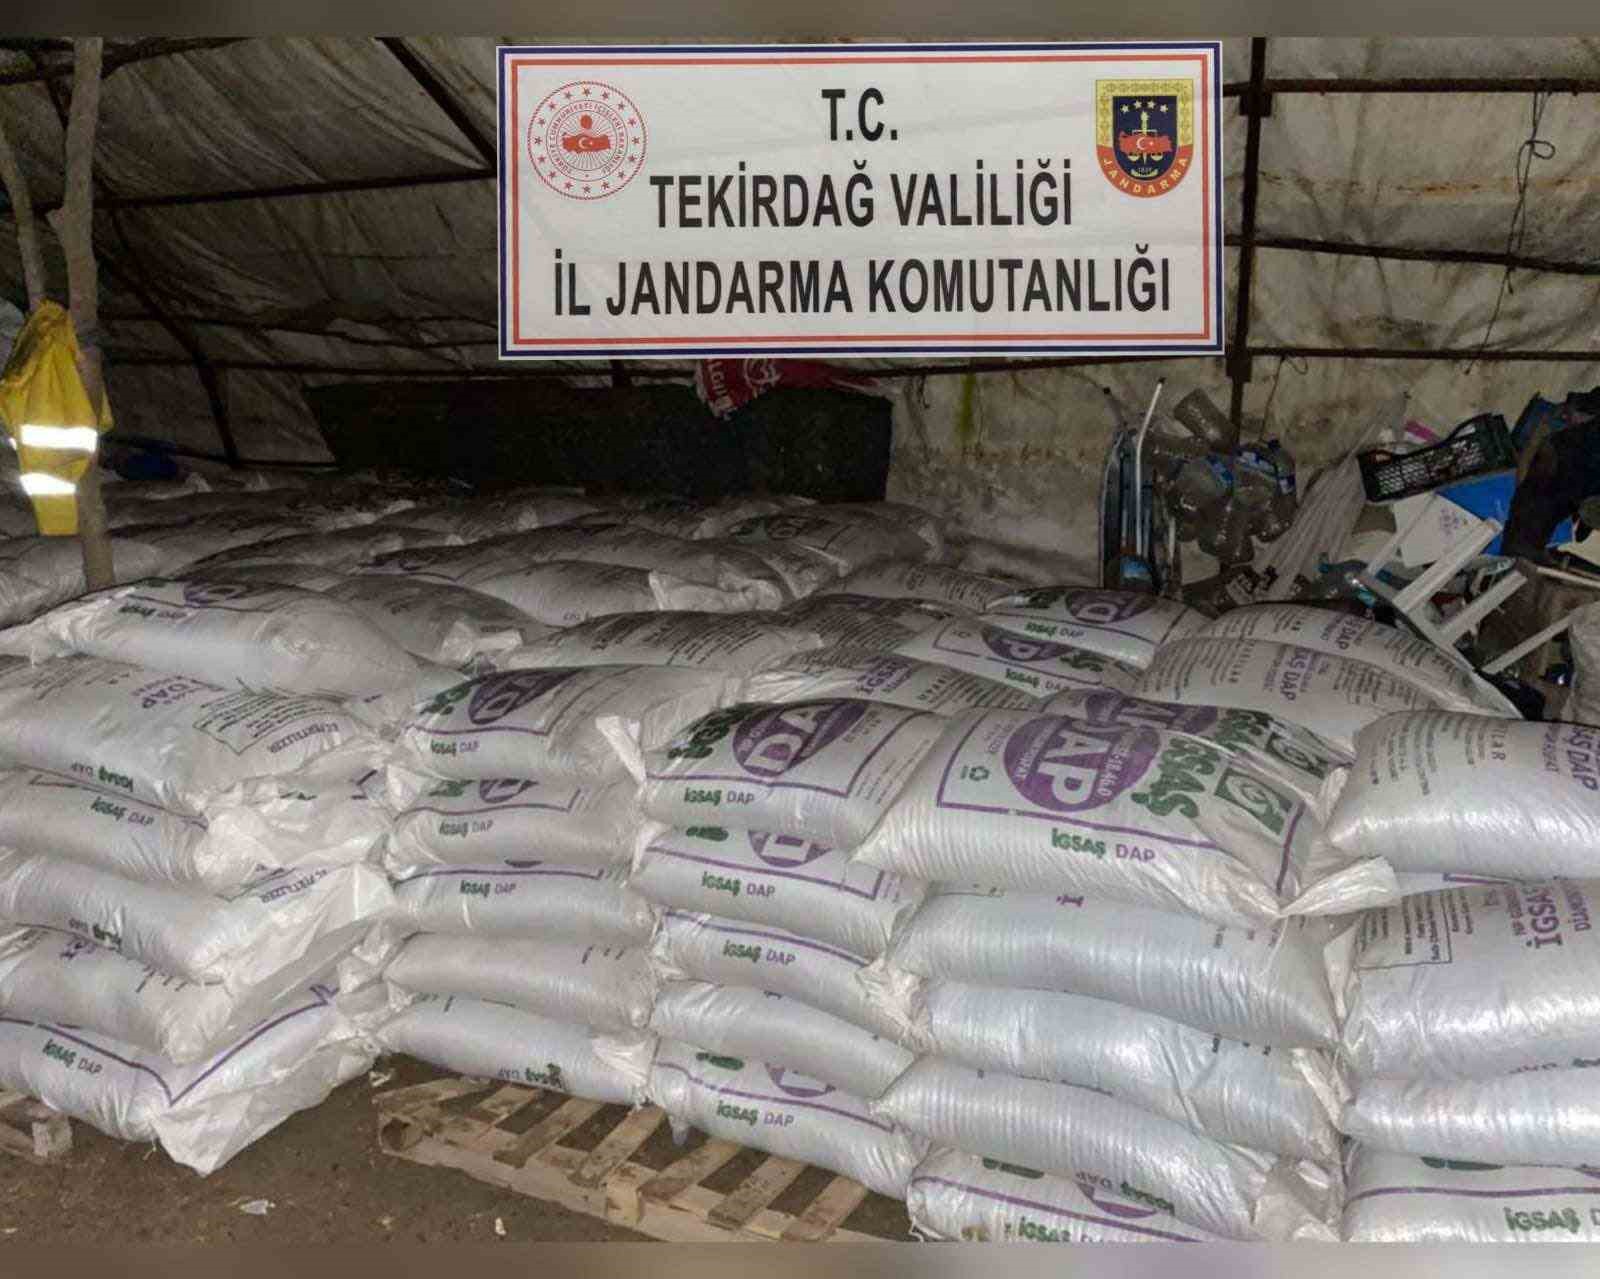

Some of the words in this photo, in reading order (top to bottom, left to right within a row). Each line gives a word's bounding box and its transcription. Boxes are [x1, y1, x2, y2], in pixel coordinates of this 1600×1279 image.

[822, 88, 898, 142] T.C.
[1103, 157, 1187, 194] JANDARMA
[650, 160, 873, 228] TEKİRDAĞ
[891, 159, 1072, 226] VALİLİĞİ
[555, 249, 591, 316] İL
[606, 260, 854, 317] JANDARMA
[869, 244, 1170, 314] KOMUTANLIĞI
[684, 787, 723, 807] İGSAŞ
[727, 789, 755, 805] DAP
[1051, 828, 1107, 860] İGSAŞ
[1115, 843, 1156, 863] DAP
[702, 872, 741, 896] İGSAŞ
[746, 882, 776, 898] DAP
[723, 940, 761, 964] İGSAŞ
[766, 950, 796, 966] DAP
[78, 1058, 104, 1076] DAP
[717, 1101, 759, 1126] İGSAŞ
[763, 1112, 795, 1128] DAP
[1504, 1207, 1581, 1234] İGSAŞ
